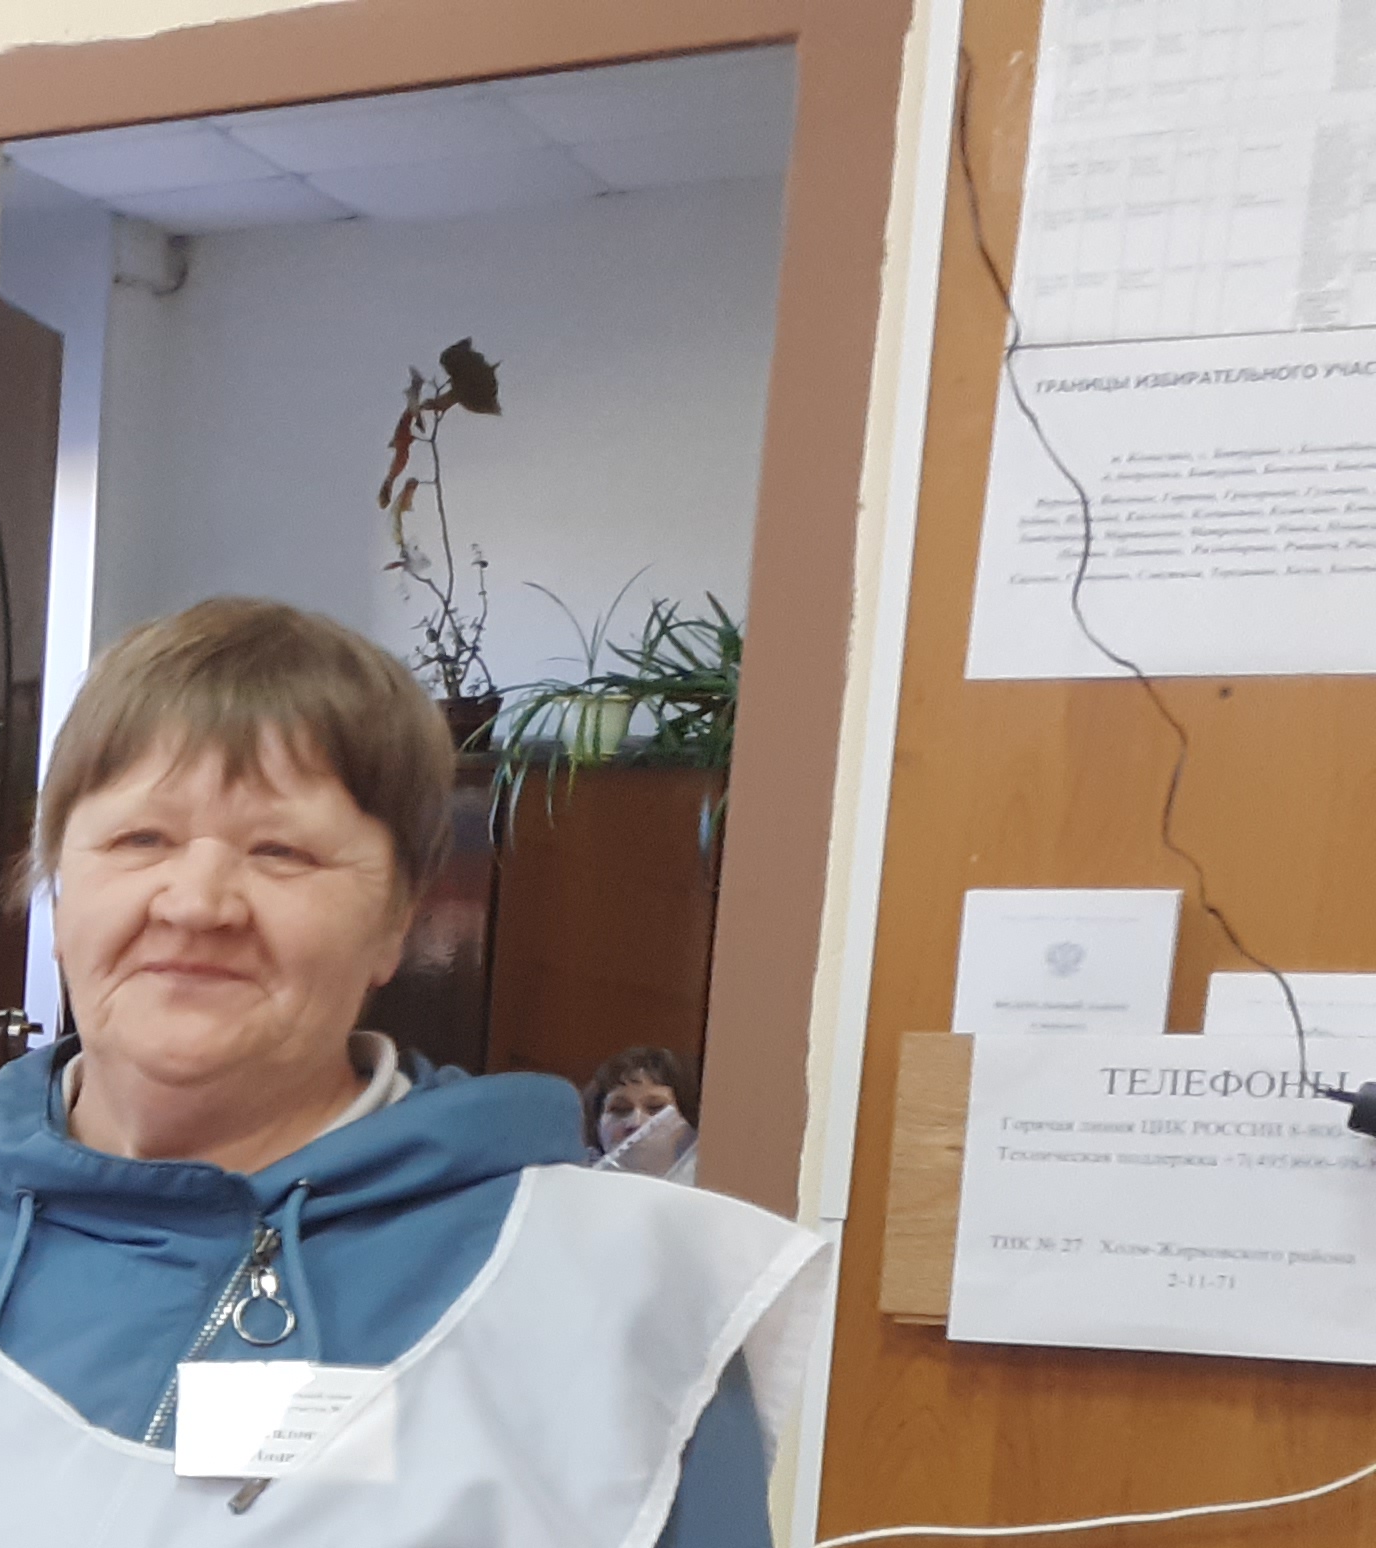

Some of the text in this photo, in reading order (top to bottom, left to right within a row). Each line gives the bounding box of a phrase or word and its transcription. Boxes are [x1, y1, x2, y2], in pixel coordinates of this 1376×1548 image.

[1035, 360, 1376, 393] ГРАНИЦЫ ИЗБИРАТЕЛЬНОГО УЧАС
